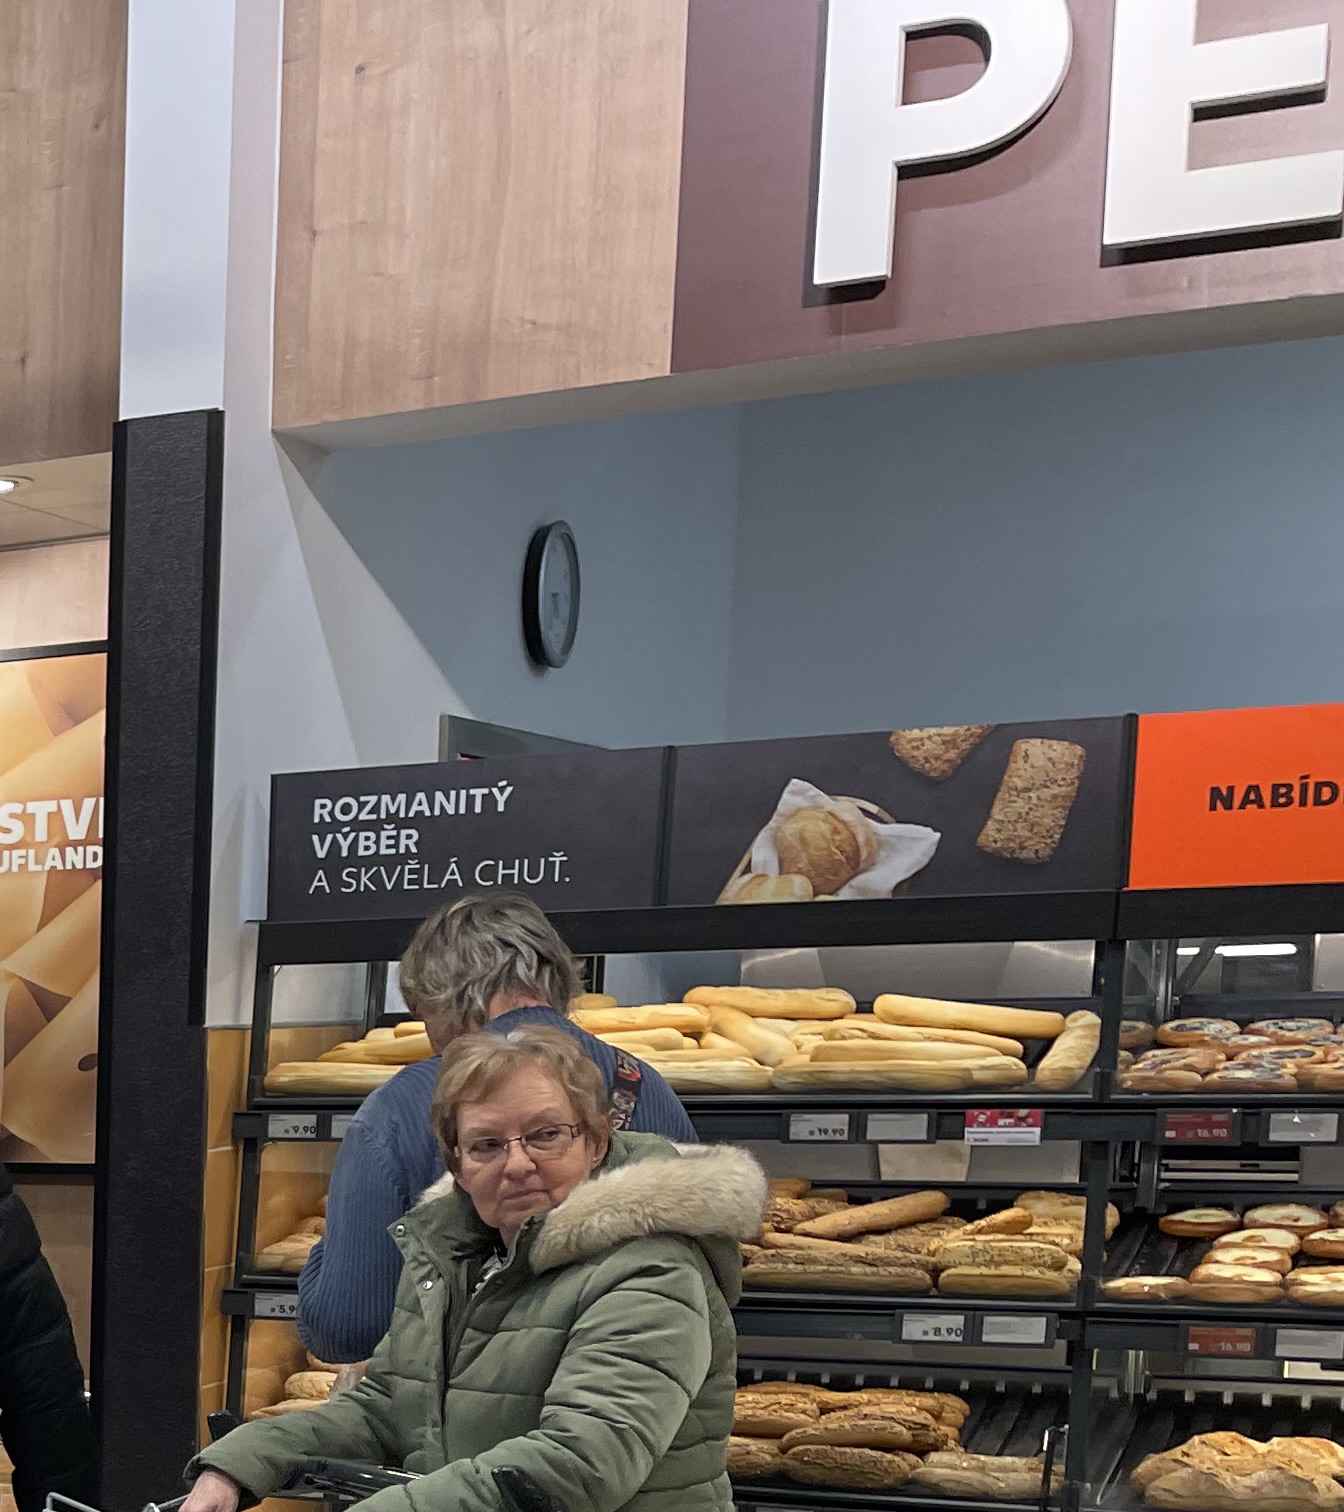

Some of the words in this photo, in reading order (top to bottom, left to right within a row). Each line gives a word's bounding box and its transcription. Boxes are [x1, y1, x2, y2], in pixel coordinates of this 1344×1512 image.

[313, 780, 514, 824] ROZMANITÝ
[1209, 774, 1344, 812] NABÍD
[312, 823, 420, 860] VÝBĚR
[309, 869, 331, 895] A
[340, 857, 463, 893] SKVĚLÁ
[474, 851, 571, 886] CHUŤ.
